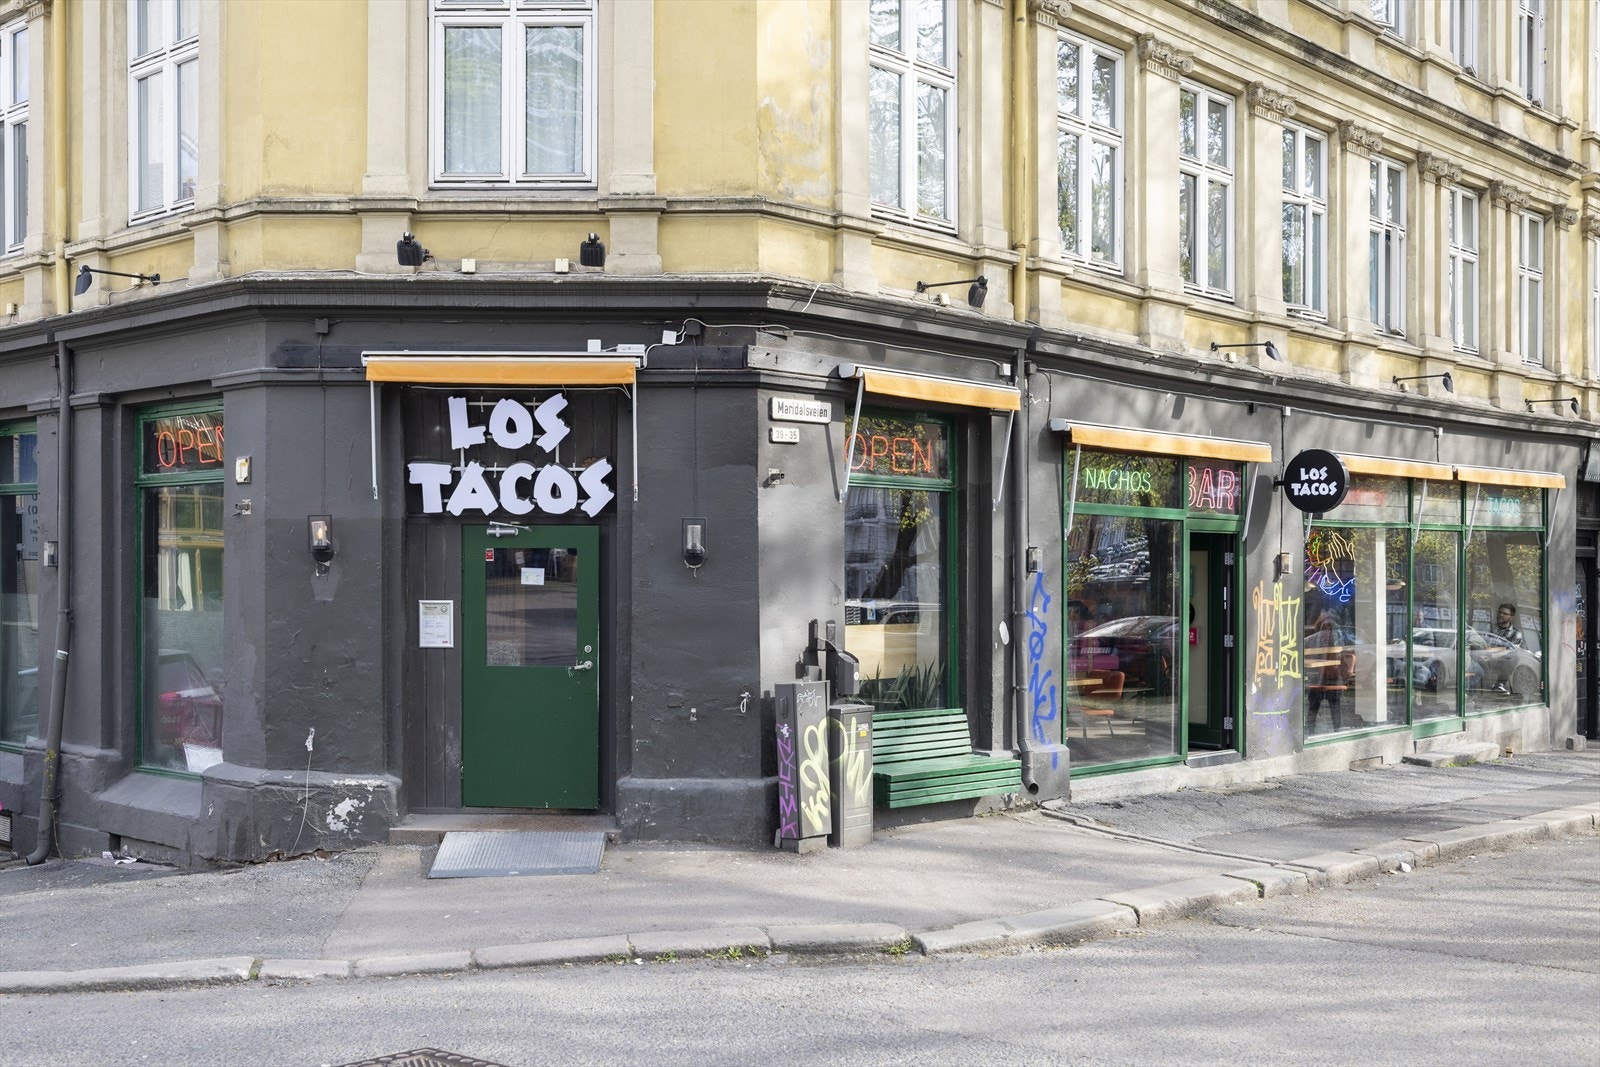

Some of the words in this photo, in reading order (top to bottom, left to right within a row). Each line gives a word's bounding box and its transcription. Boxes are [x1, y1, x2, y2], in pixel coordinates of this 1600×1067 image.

[448, 392, 570, 454] LOS
[777, 400, 828, 418] Maridalsveien
[843, 433, 932, 474] OPEN
[407, 457, 615, 518] TACOS
[1084, 467, 1151, 493] NACHOS
[1188, 466, 1235, 510] BAR
[1290, 481, 1338, 497] TACOS
[1300, 466, 1328, 481] LOS
